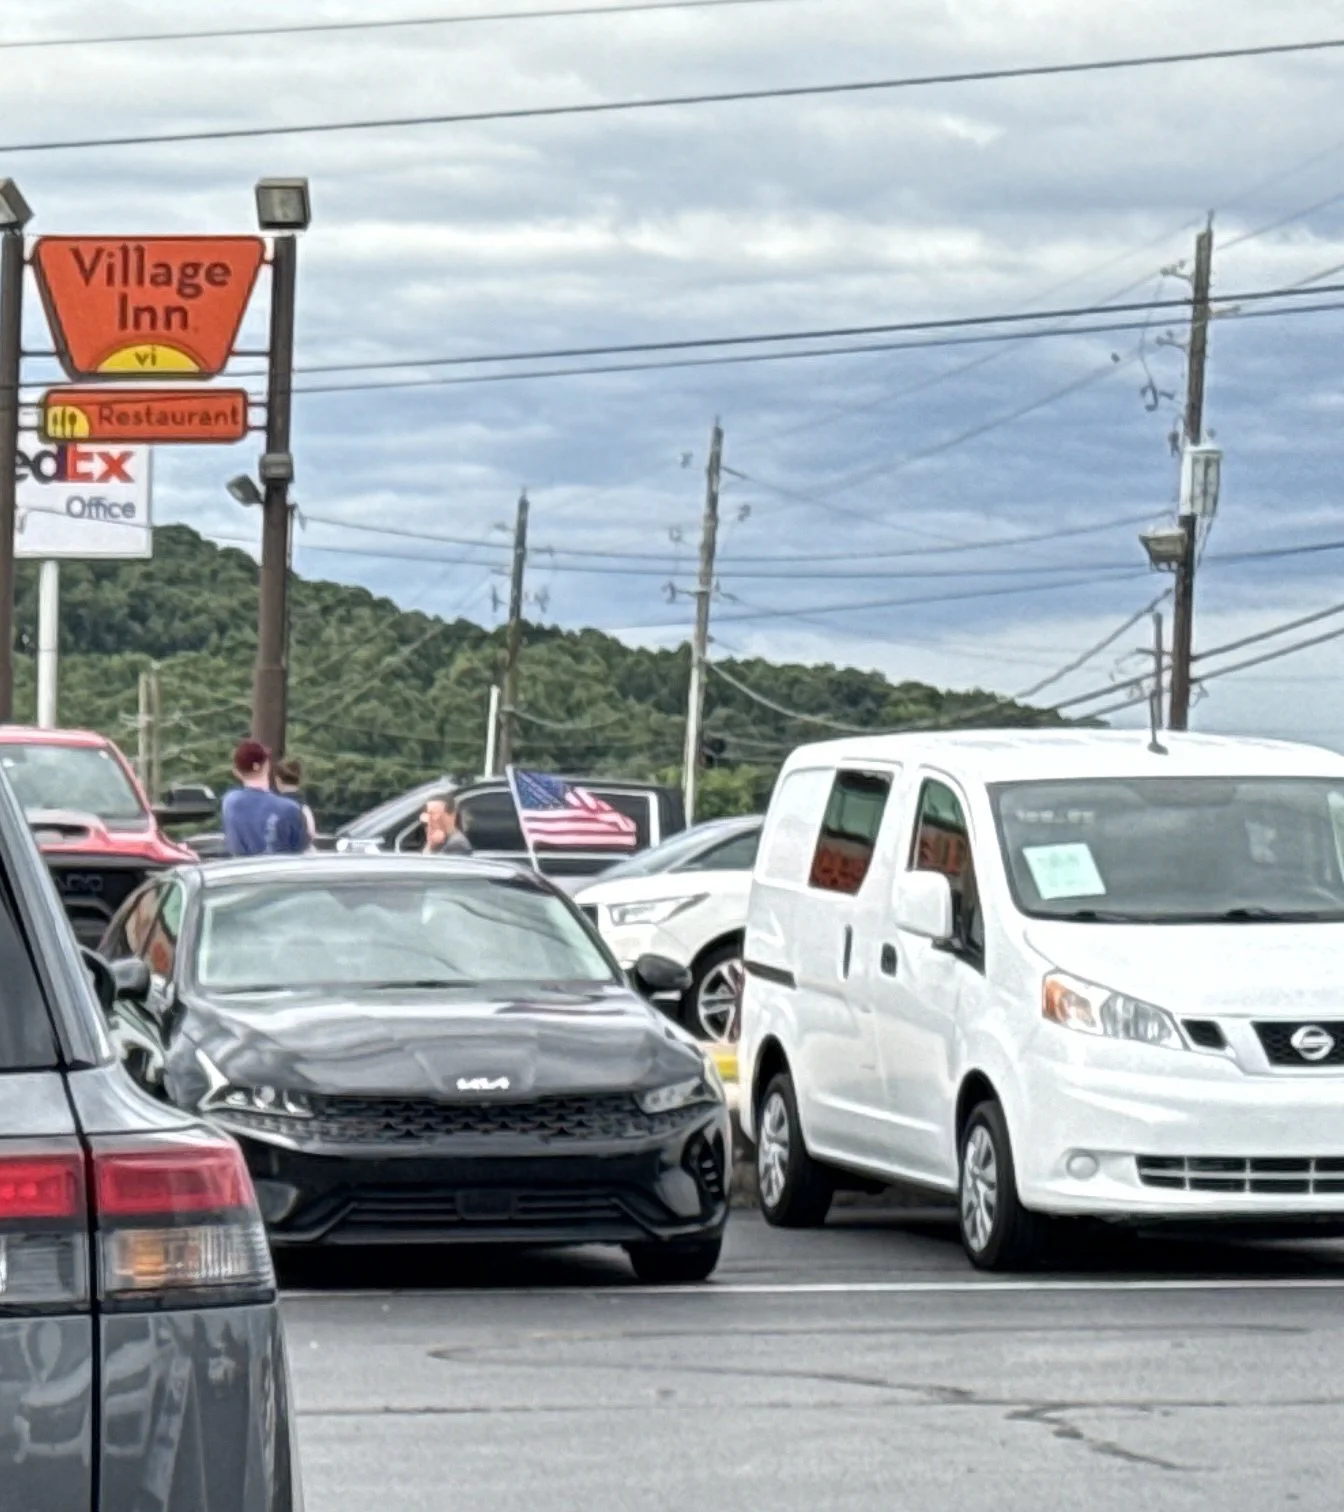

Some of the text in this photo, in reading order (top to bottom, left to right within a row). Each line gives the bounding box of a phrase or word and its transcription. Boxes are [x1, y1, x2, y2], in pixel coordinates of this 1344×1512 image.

[69, 243, 232, 300] Village
[118, 292, 190, 331] Inn
[98, 404, 241, 427] Restaurant
[65, 495, 137, 520] Office
